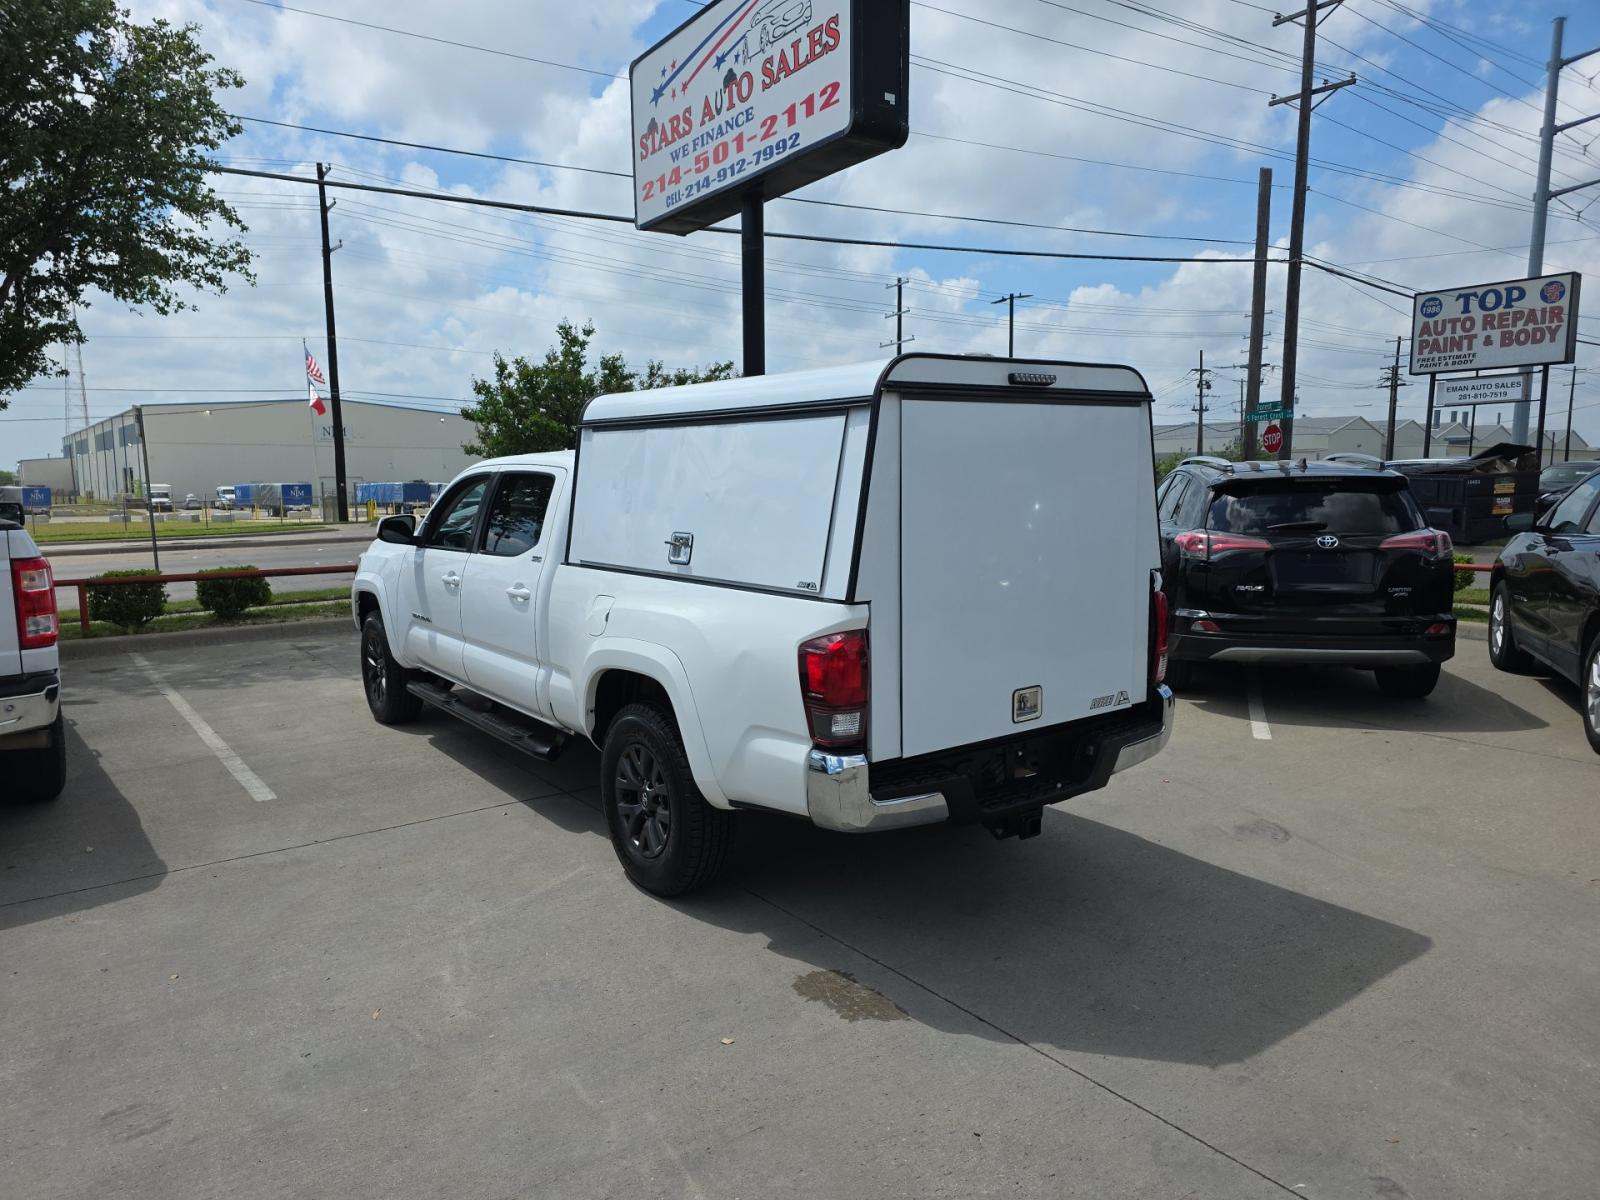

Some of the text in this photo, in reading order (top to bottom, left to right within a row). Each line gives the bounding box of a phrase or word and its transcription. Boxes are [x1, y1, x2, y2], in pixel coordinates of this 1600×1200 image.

[640, 13, 841, 161] STARS AUTO SALES
[642, 81, 841, 202] 214-501-2112
[670, 106, 755, 163] WE FINANCE
[1456, 286, 1527, 314] TOP
[1418, 305, 1565, 338] AUTO REPAIR
[1418, 324, 1563, 355] PAINT & BODY
[1416, 353, 1478, 364] FREE ESTIMATE
[1446, 381, 1522, 393] EMAN AUTO SALES
[1264, 432, 1281, 446] STOP
